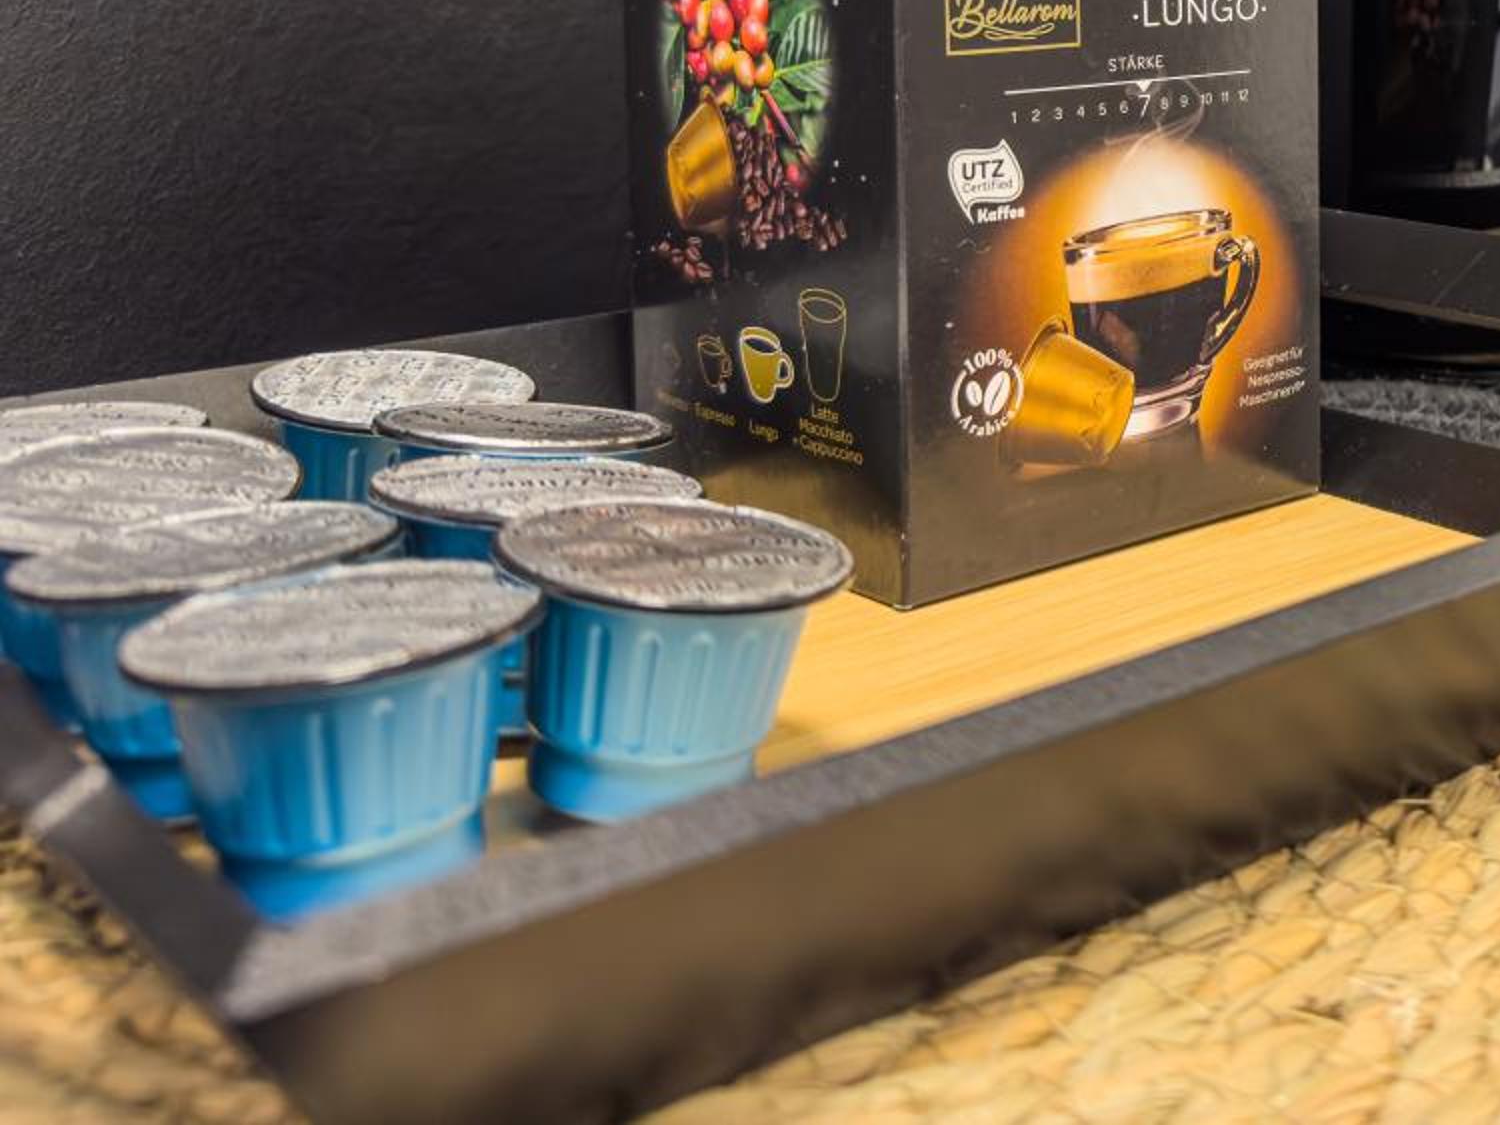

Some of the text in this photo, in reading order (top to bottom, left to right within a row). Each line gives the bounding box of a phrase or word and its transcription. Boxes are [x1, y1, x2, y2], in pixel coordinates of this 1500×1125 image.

[1032, 109, 1041, 122] 2
[1055, 107, 1063, 120] 3
[1076, 106, 1085, 118] 4
[1099, 103, 1107, 116] 5
[1120, 101, 1128, 114] 6
[1138, 94, 1151, 118] 7
[1160, 97, 1169, 110] 8
[1180, 94, 1189, 107] 9
[1201, 93, 1212, 106] 10
[962, 159, 1005, 180] UTZ
[961, 178, 1013, 193] Certified
[977, 204, 1025, 223] Kaffee
[963, 348, 1013, 374] 100%
[811, 402, 839, 423] Latte
